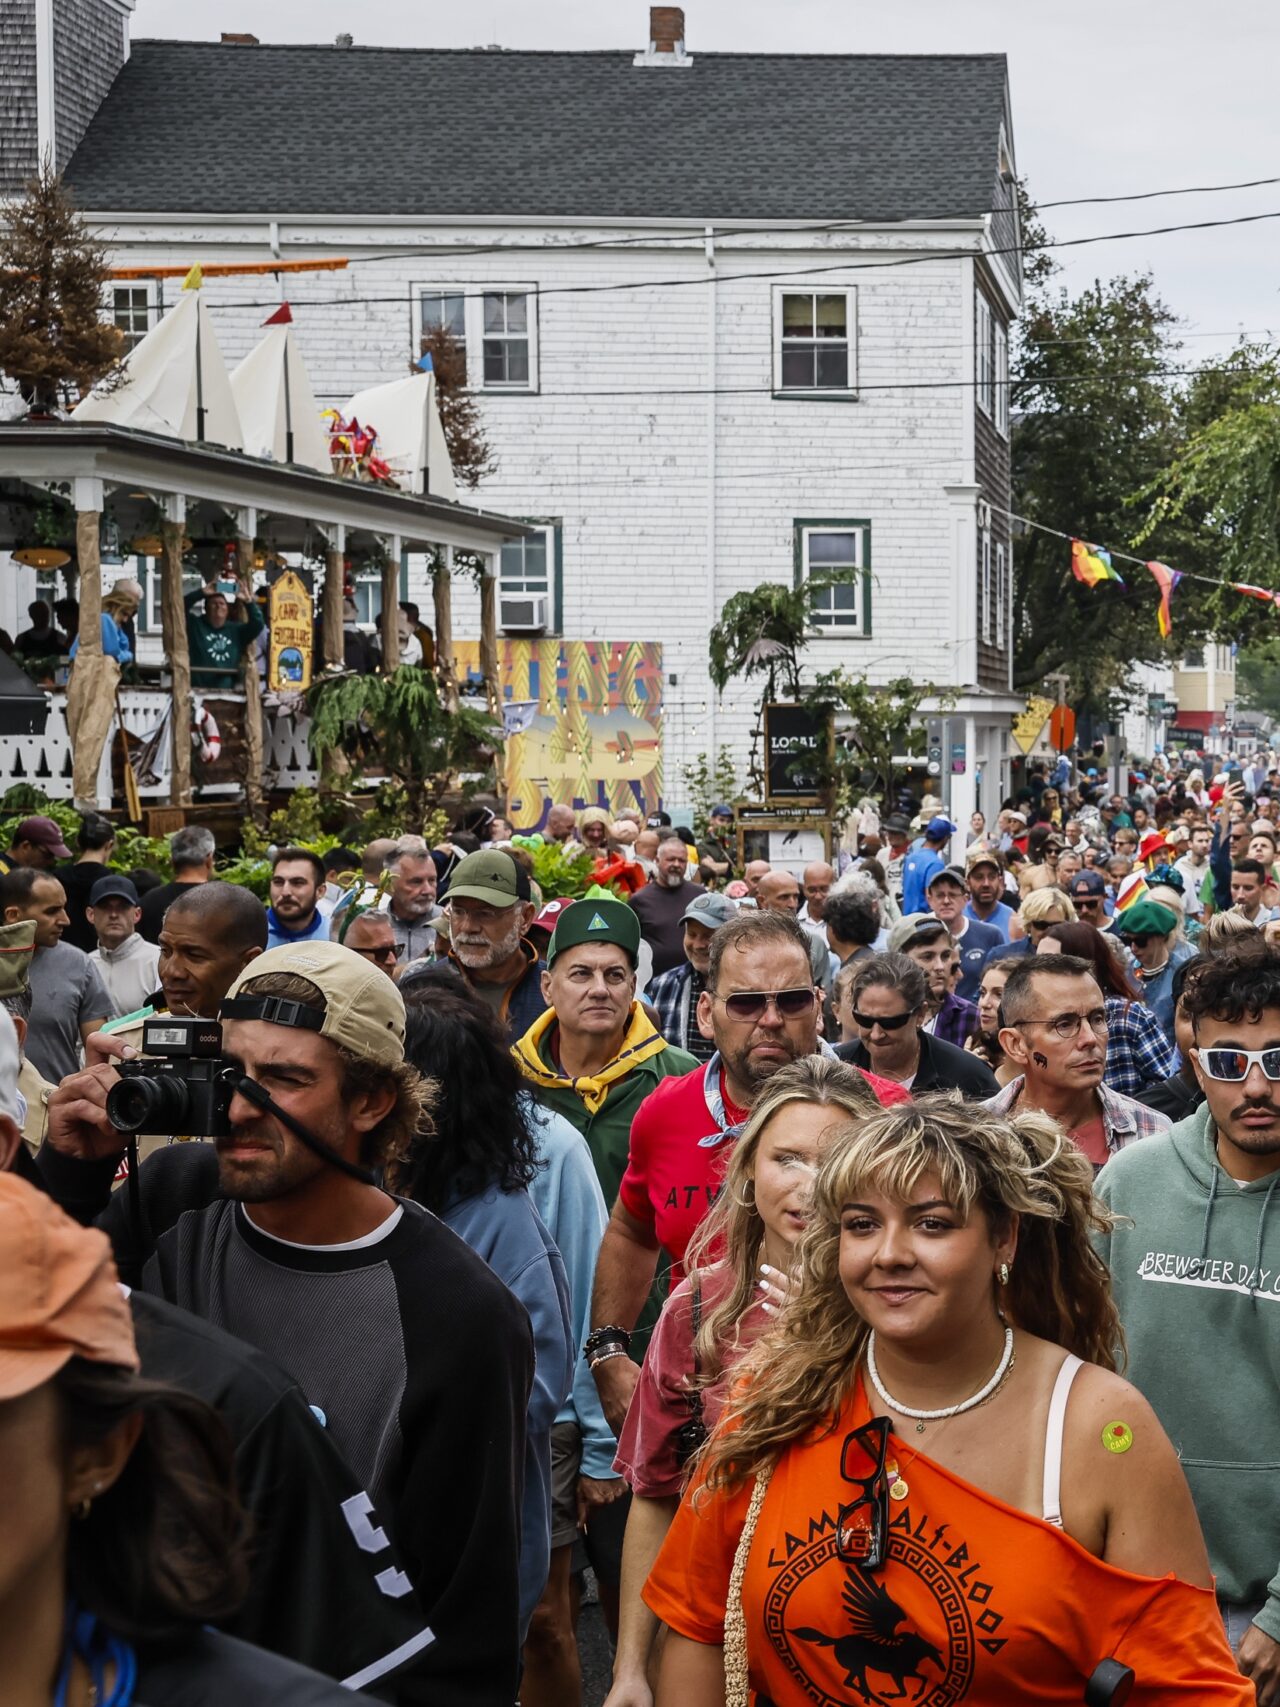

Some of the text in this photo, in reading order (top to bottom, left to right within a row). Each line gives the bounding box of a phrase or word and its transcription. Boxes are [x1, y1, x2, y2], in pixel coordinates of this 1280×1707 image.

[1143, 1251, 1233, 1283] BREWSTER
[1238, 1263, 1272, 1289] DAY
[1110, 1434, 1130, 1450] CAMP
[767, 1502, 846, 1569] CAM
